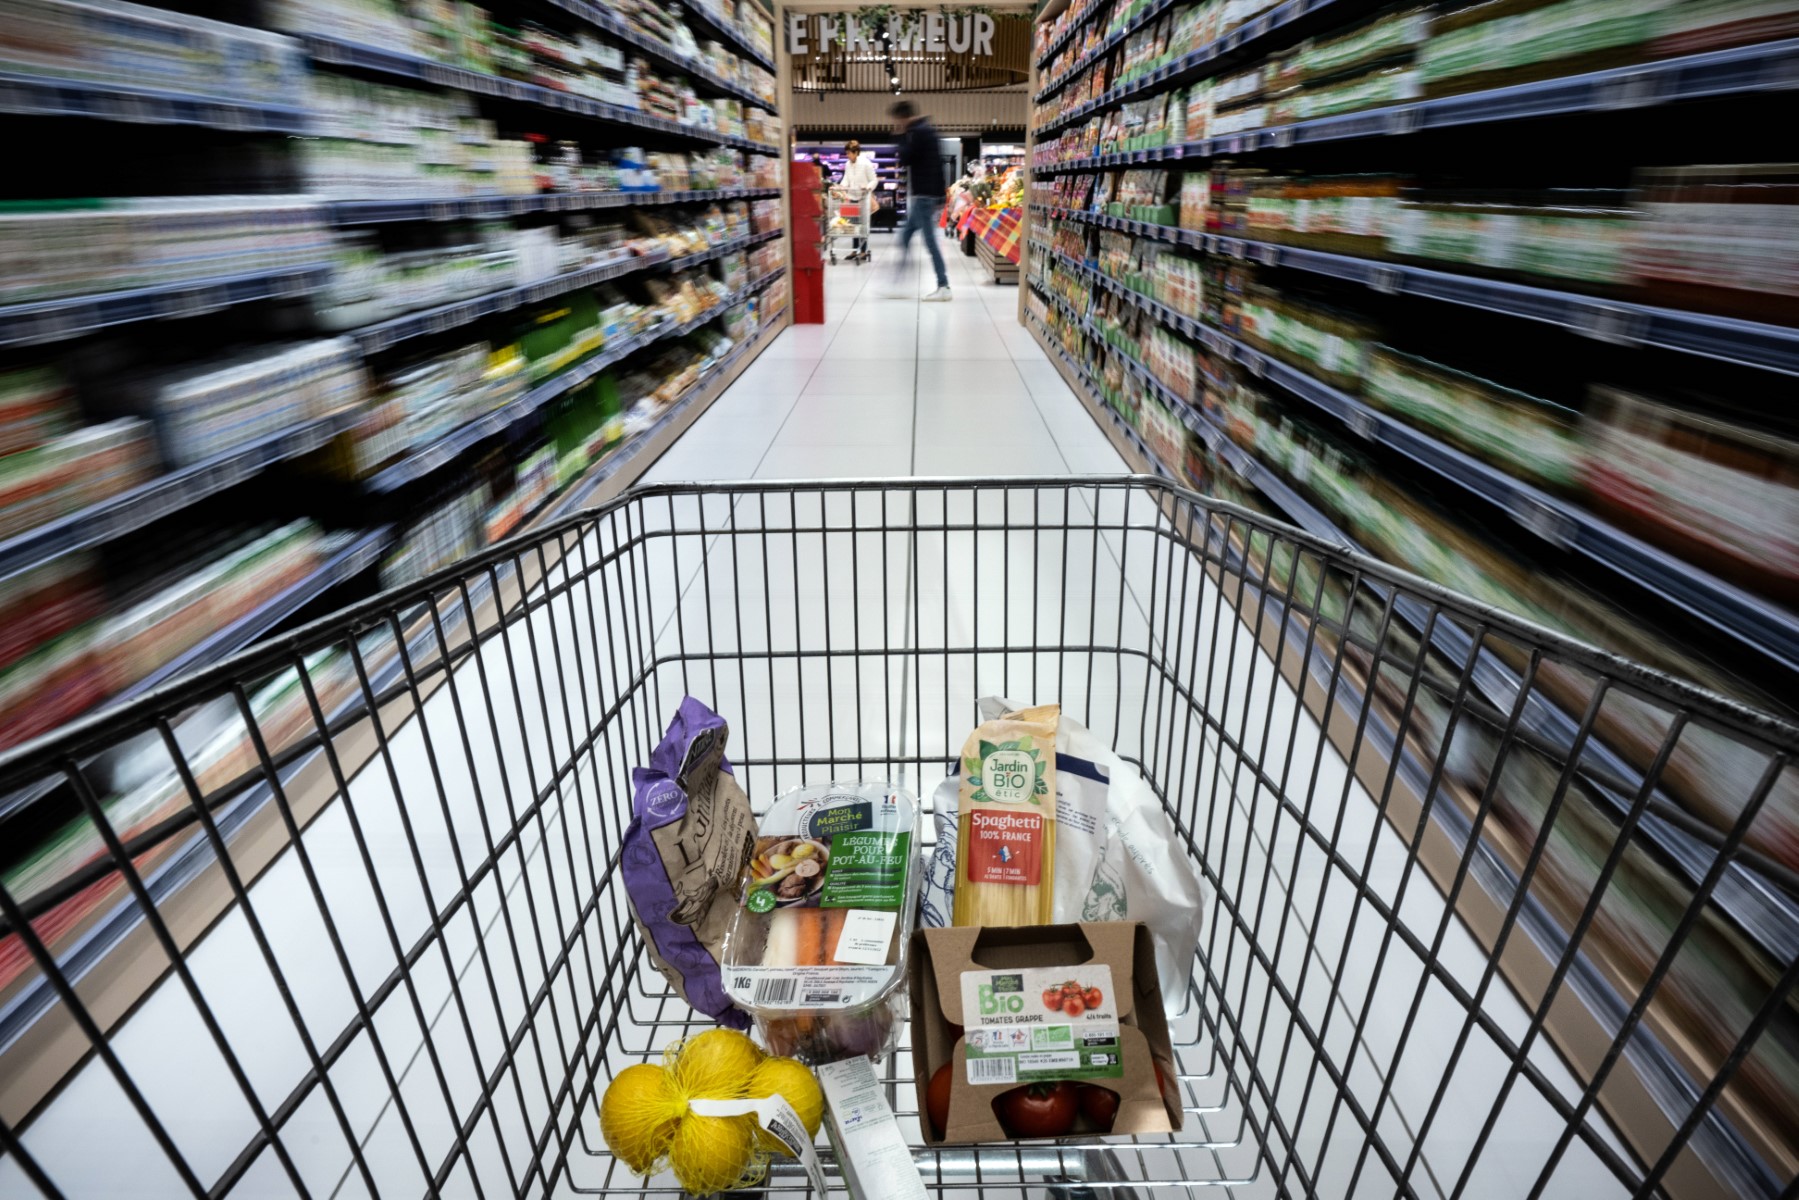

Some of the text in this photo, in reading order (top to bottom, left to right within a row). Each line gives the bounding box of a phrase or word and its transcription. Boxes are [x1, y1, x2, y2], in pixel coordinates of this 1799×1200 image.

[820, 12, 995, 55] PRMEUR
[990, 759, 1028, 772] Jardin
[650, 790, 678, 806] ZÉRO
[995, 790, 1020, 798] étic
[828, 807, 851, 817] Mon
[817, 812, 862, 827] Marché
[972, 813, 1040, 830] Spaghetti
[821, 823, 859, 834] Plaisir
[980, 831, 1031, 841] 100% FRANCE
[853, 846, 885, 855] POUR
[832, 855, 903, 866] POT-AU-FEU
[756, 896, 766, 907] 4
[733, 976, 752, 989] 1KG
[978, 984, 1024, 1015] Bio
[981, 1014, 1043, 1025] TOMATES GRAPPE
